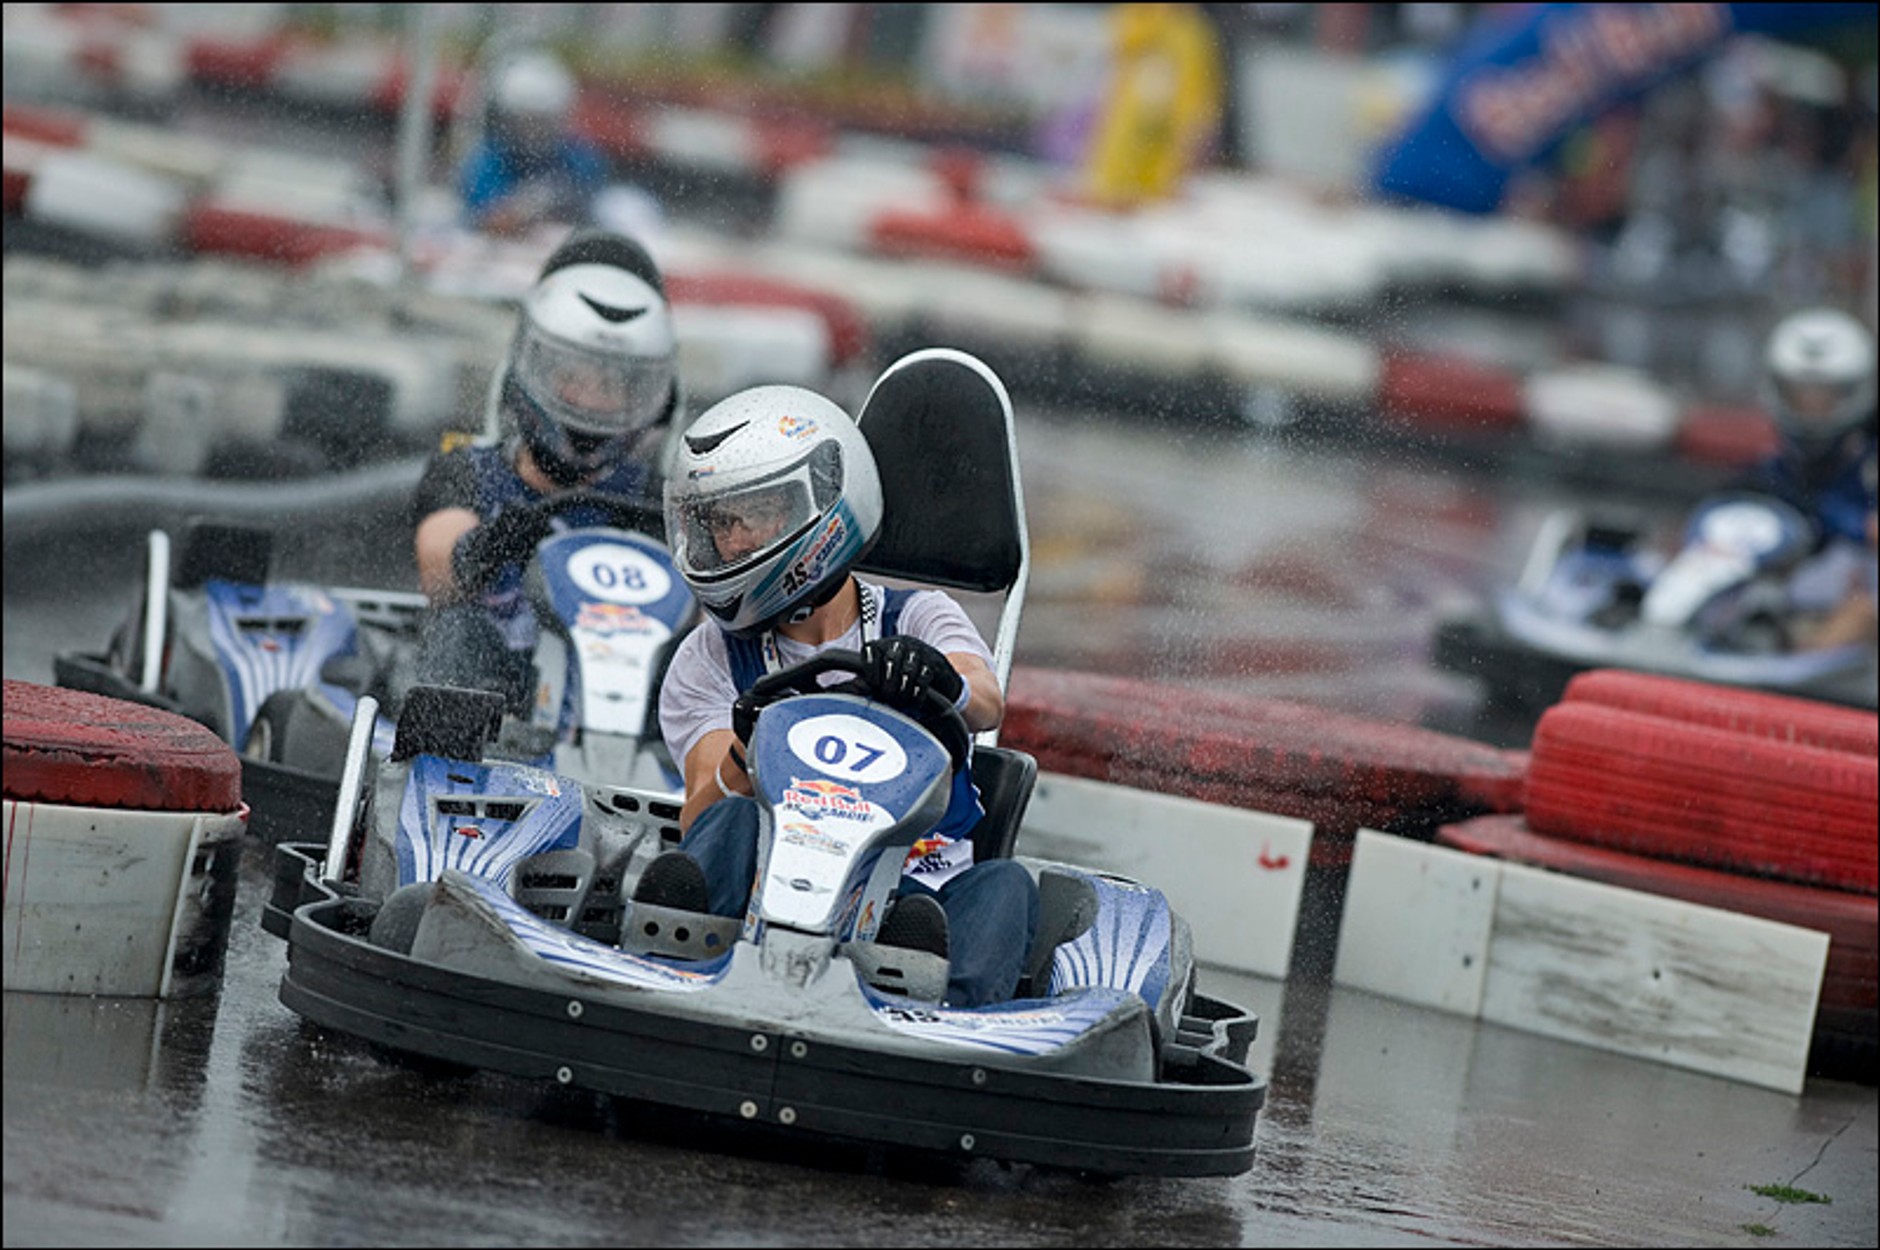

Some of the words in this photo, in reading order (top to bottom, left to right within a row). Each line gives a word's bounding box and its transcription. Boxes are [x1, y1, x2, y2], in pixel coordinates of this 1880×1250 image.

[592, 562, 647, 591] 08
[813, 734, 887, 773] 07
[785, 790, 828, 807] Red
[829, 796, 871, 813] Bull
